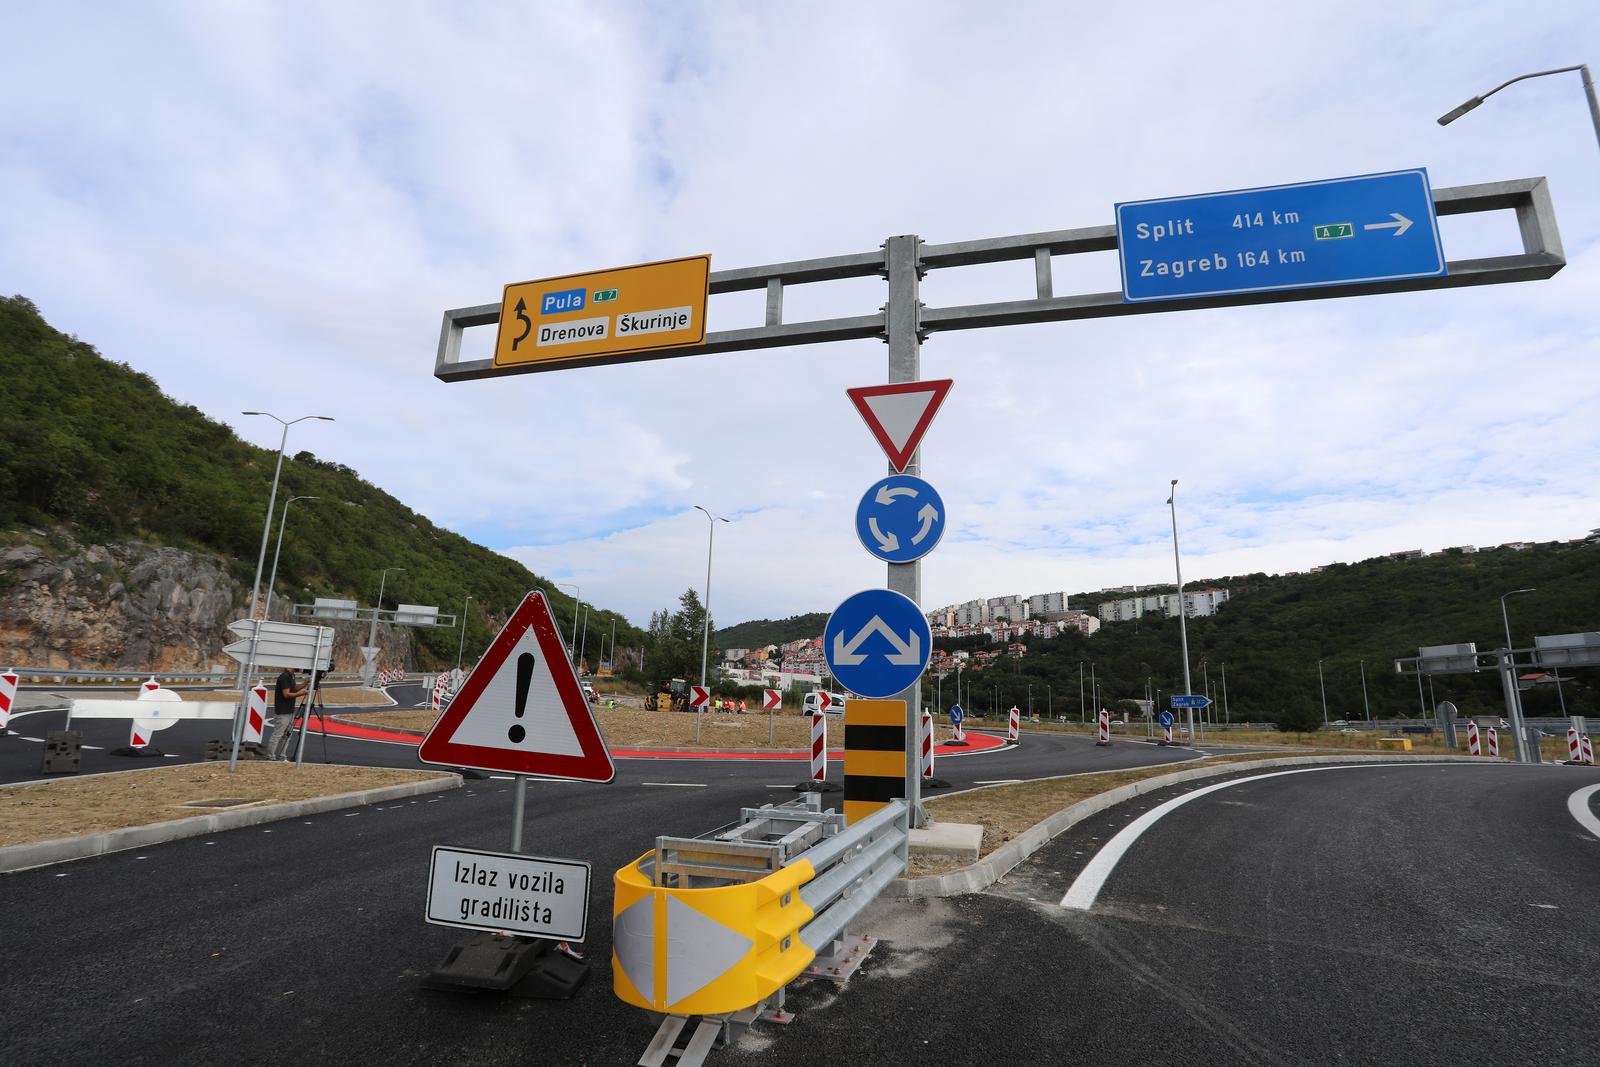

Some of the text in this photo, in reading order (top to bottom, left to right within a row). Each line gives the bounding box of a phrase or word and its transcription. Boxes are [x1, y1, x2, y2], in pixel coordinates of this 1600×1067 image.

[1136, 211, 1300, 241] Split 414 km
[1323, 226, 1345, 237] A 7
[1140, 248, 1306, 278] Zagreb 164 km
[544, 294, 581, 310] Pula
[541, 323, 604, 342] Drenova
[620, 313, 687, 332] Škurinje
[454, 861, 564, 895] Izlaz vozila
[460, 897, 552, 924] gradilišta
